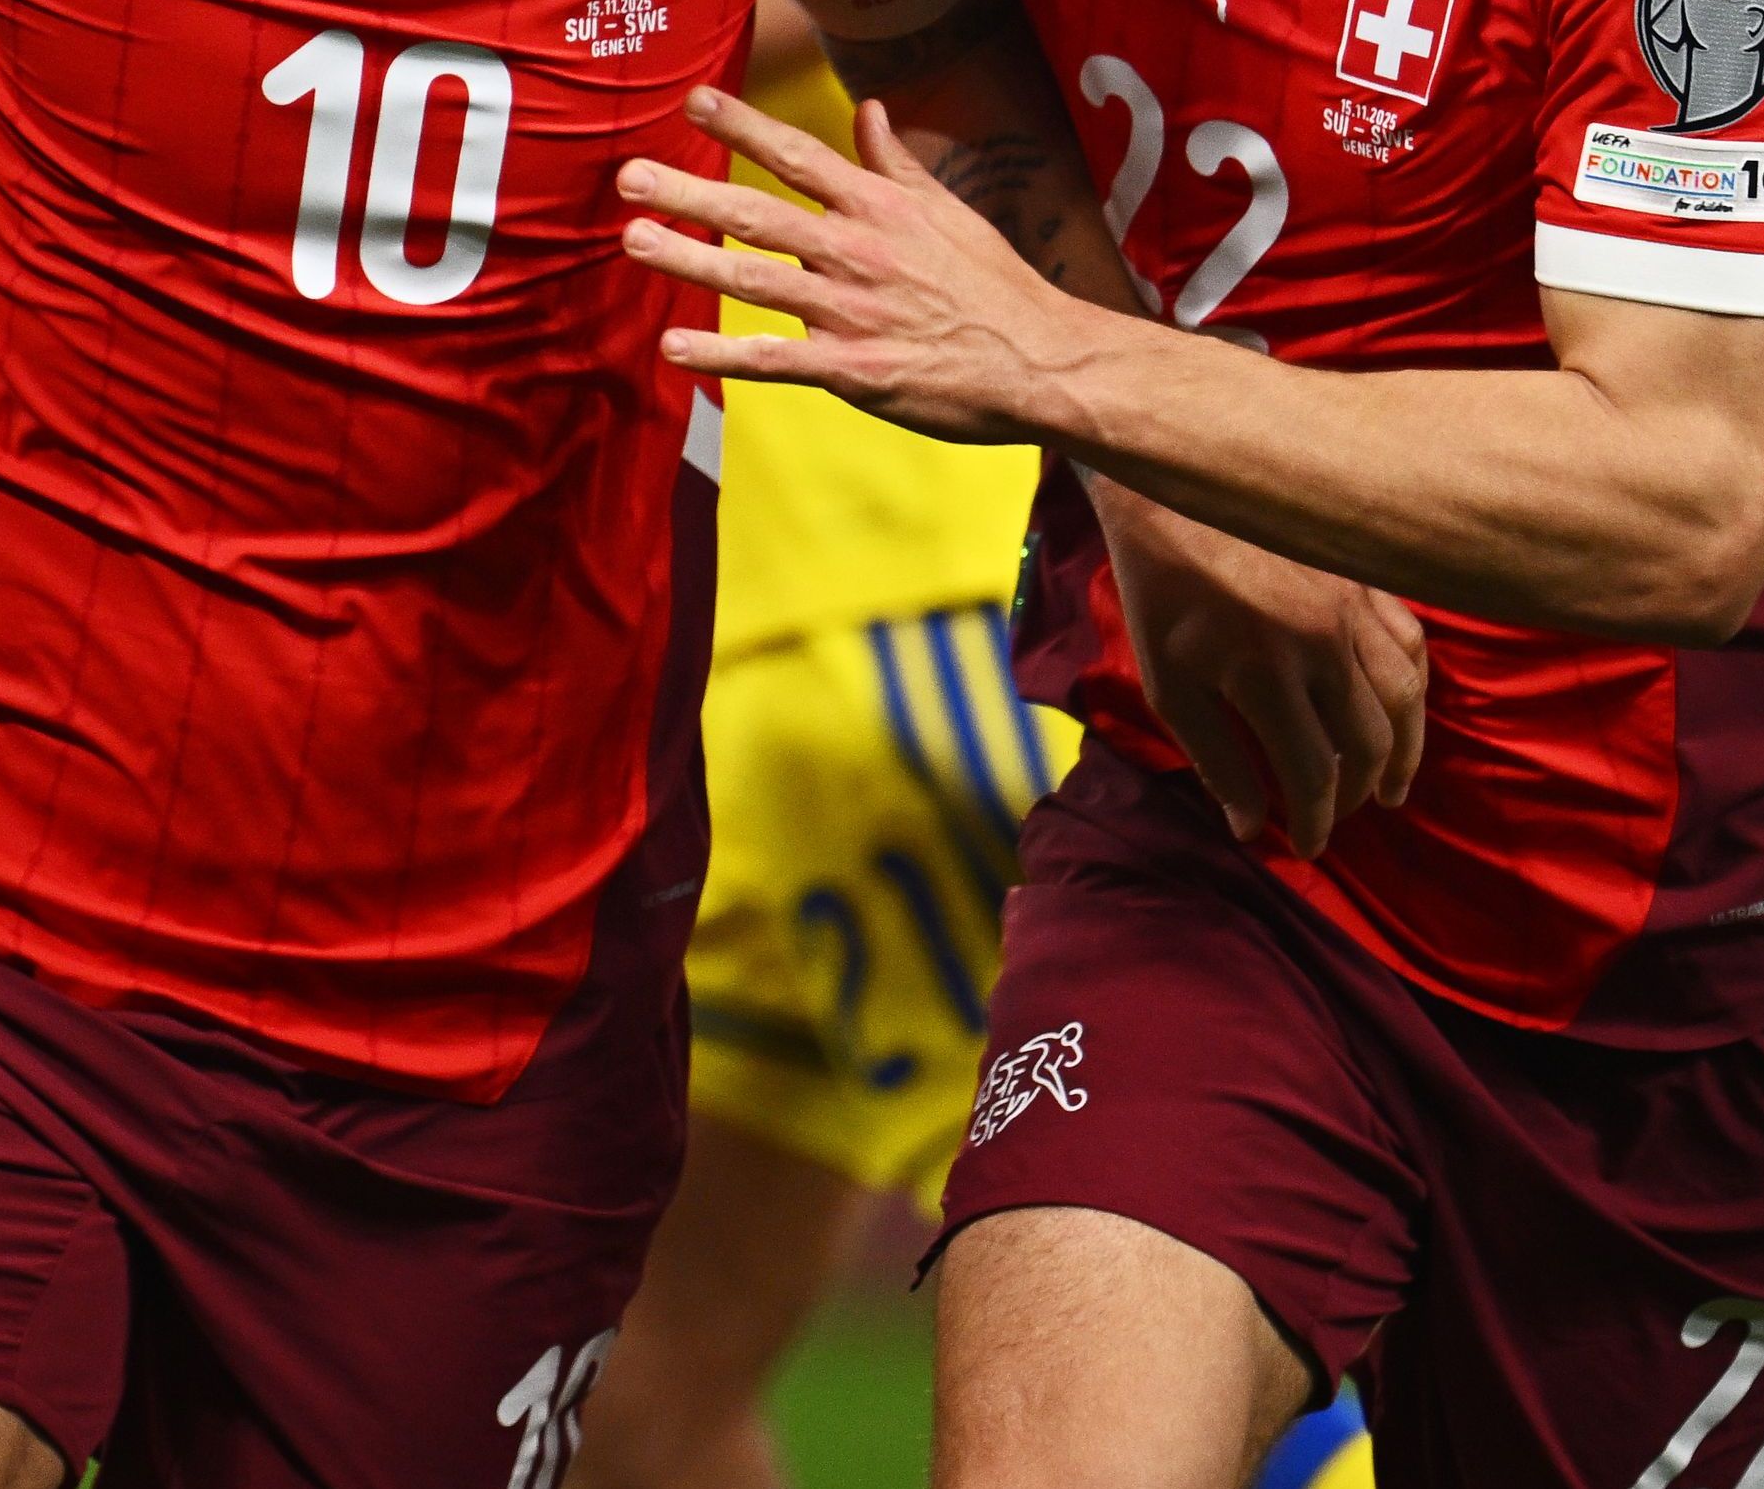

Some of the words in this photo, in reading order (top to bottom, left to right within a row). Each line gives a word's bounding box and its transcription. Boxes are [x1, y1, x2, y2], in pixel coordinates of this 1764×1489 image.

[565, 17, 597, 42] SUI
[625, 7, 668, 36] SWE
[591, 35, 643, 58] GENEVE
[1323, 108, 1350, 137] SUI
[1371, 125, 1415, 151] SWE
[1341, 98, 1398, 131] 15.11.2025
[1592, 131, 1631, 149] UEFA
[260, 28, 513, 306] 10
[1079, 54, 1289, 355] 22
[1674, 198, 1691, 213] for
